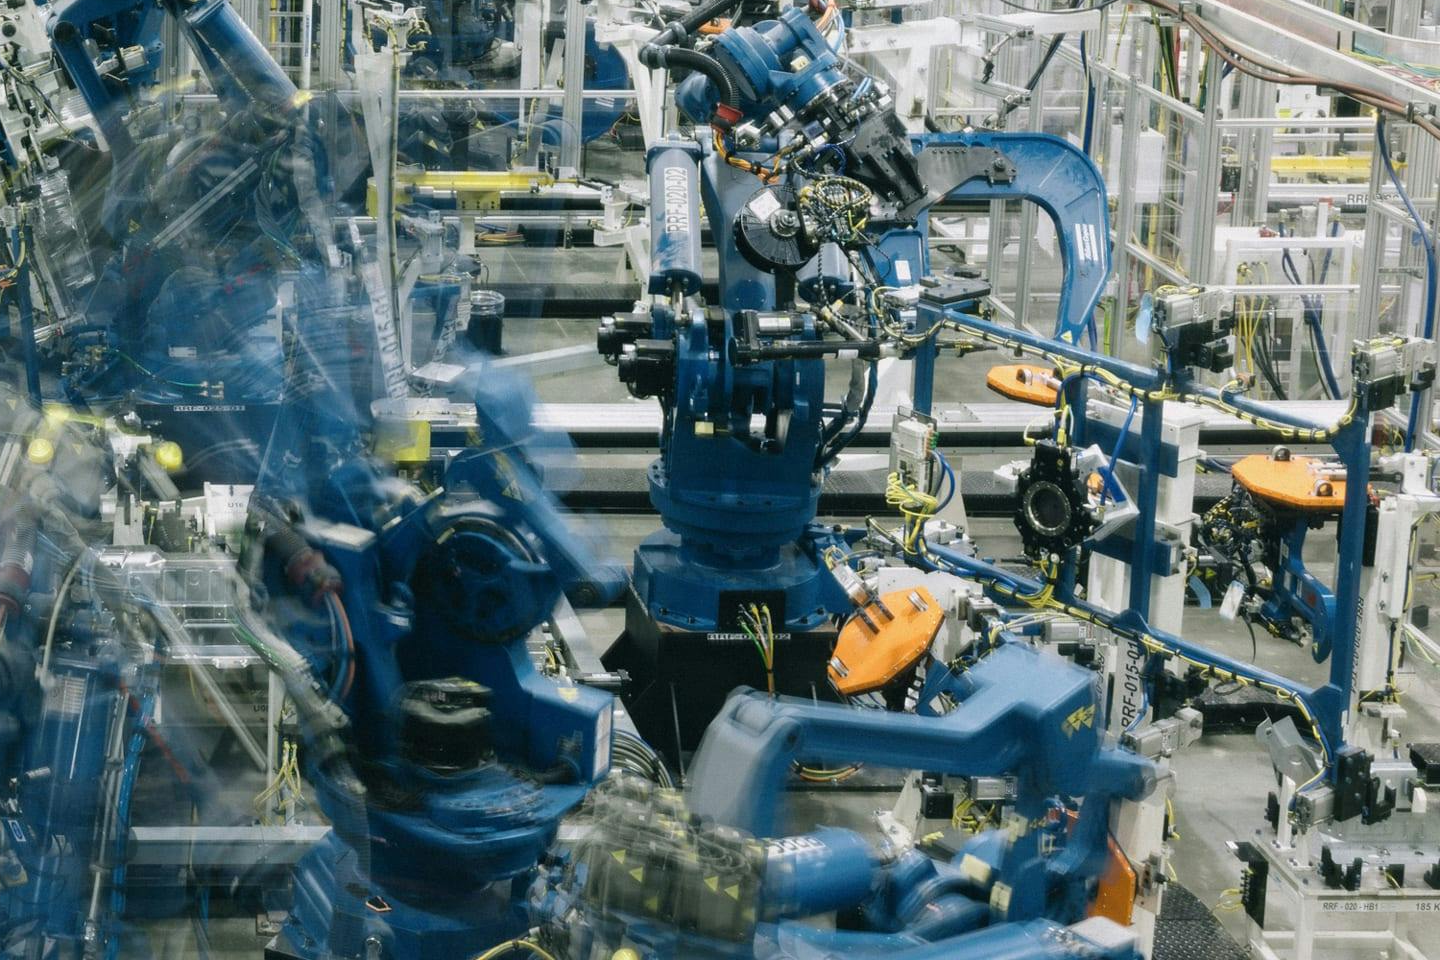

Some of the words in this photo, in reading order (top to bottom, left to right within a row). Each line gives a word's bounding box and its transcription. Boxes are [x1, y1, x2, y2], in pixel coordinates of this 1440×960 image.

[665, 168, 687, 232] RRF-020-02
[1323, 902, 1338, 911] RRF
[1344, 902, 1358, 911] 020
[1416, 903, 1431, 911] 185
